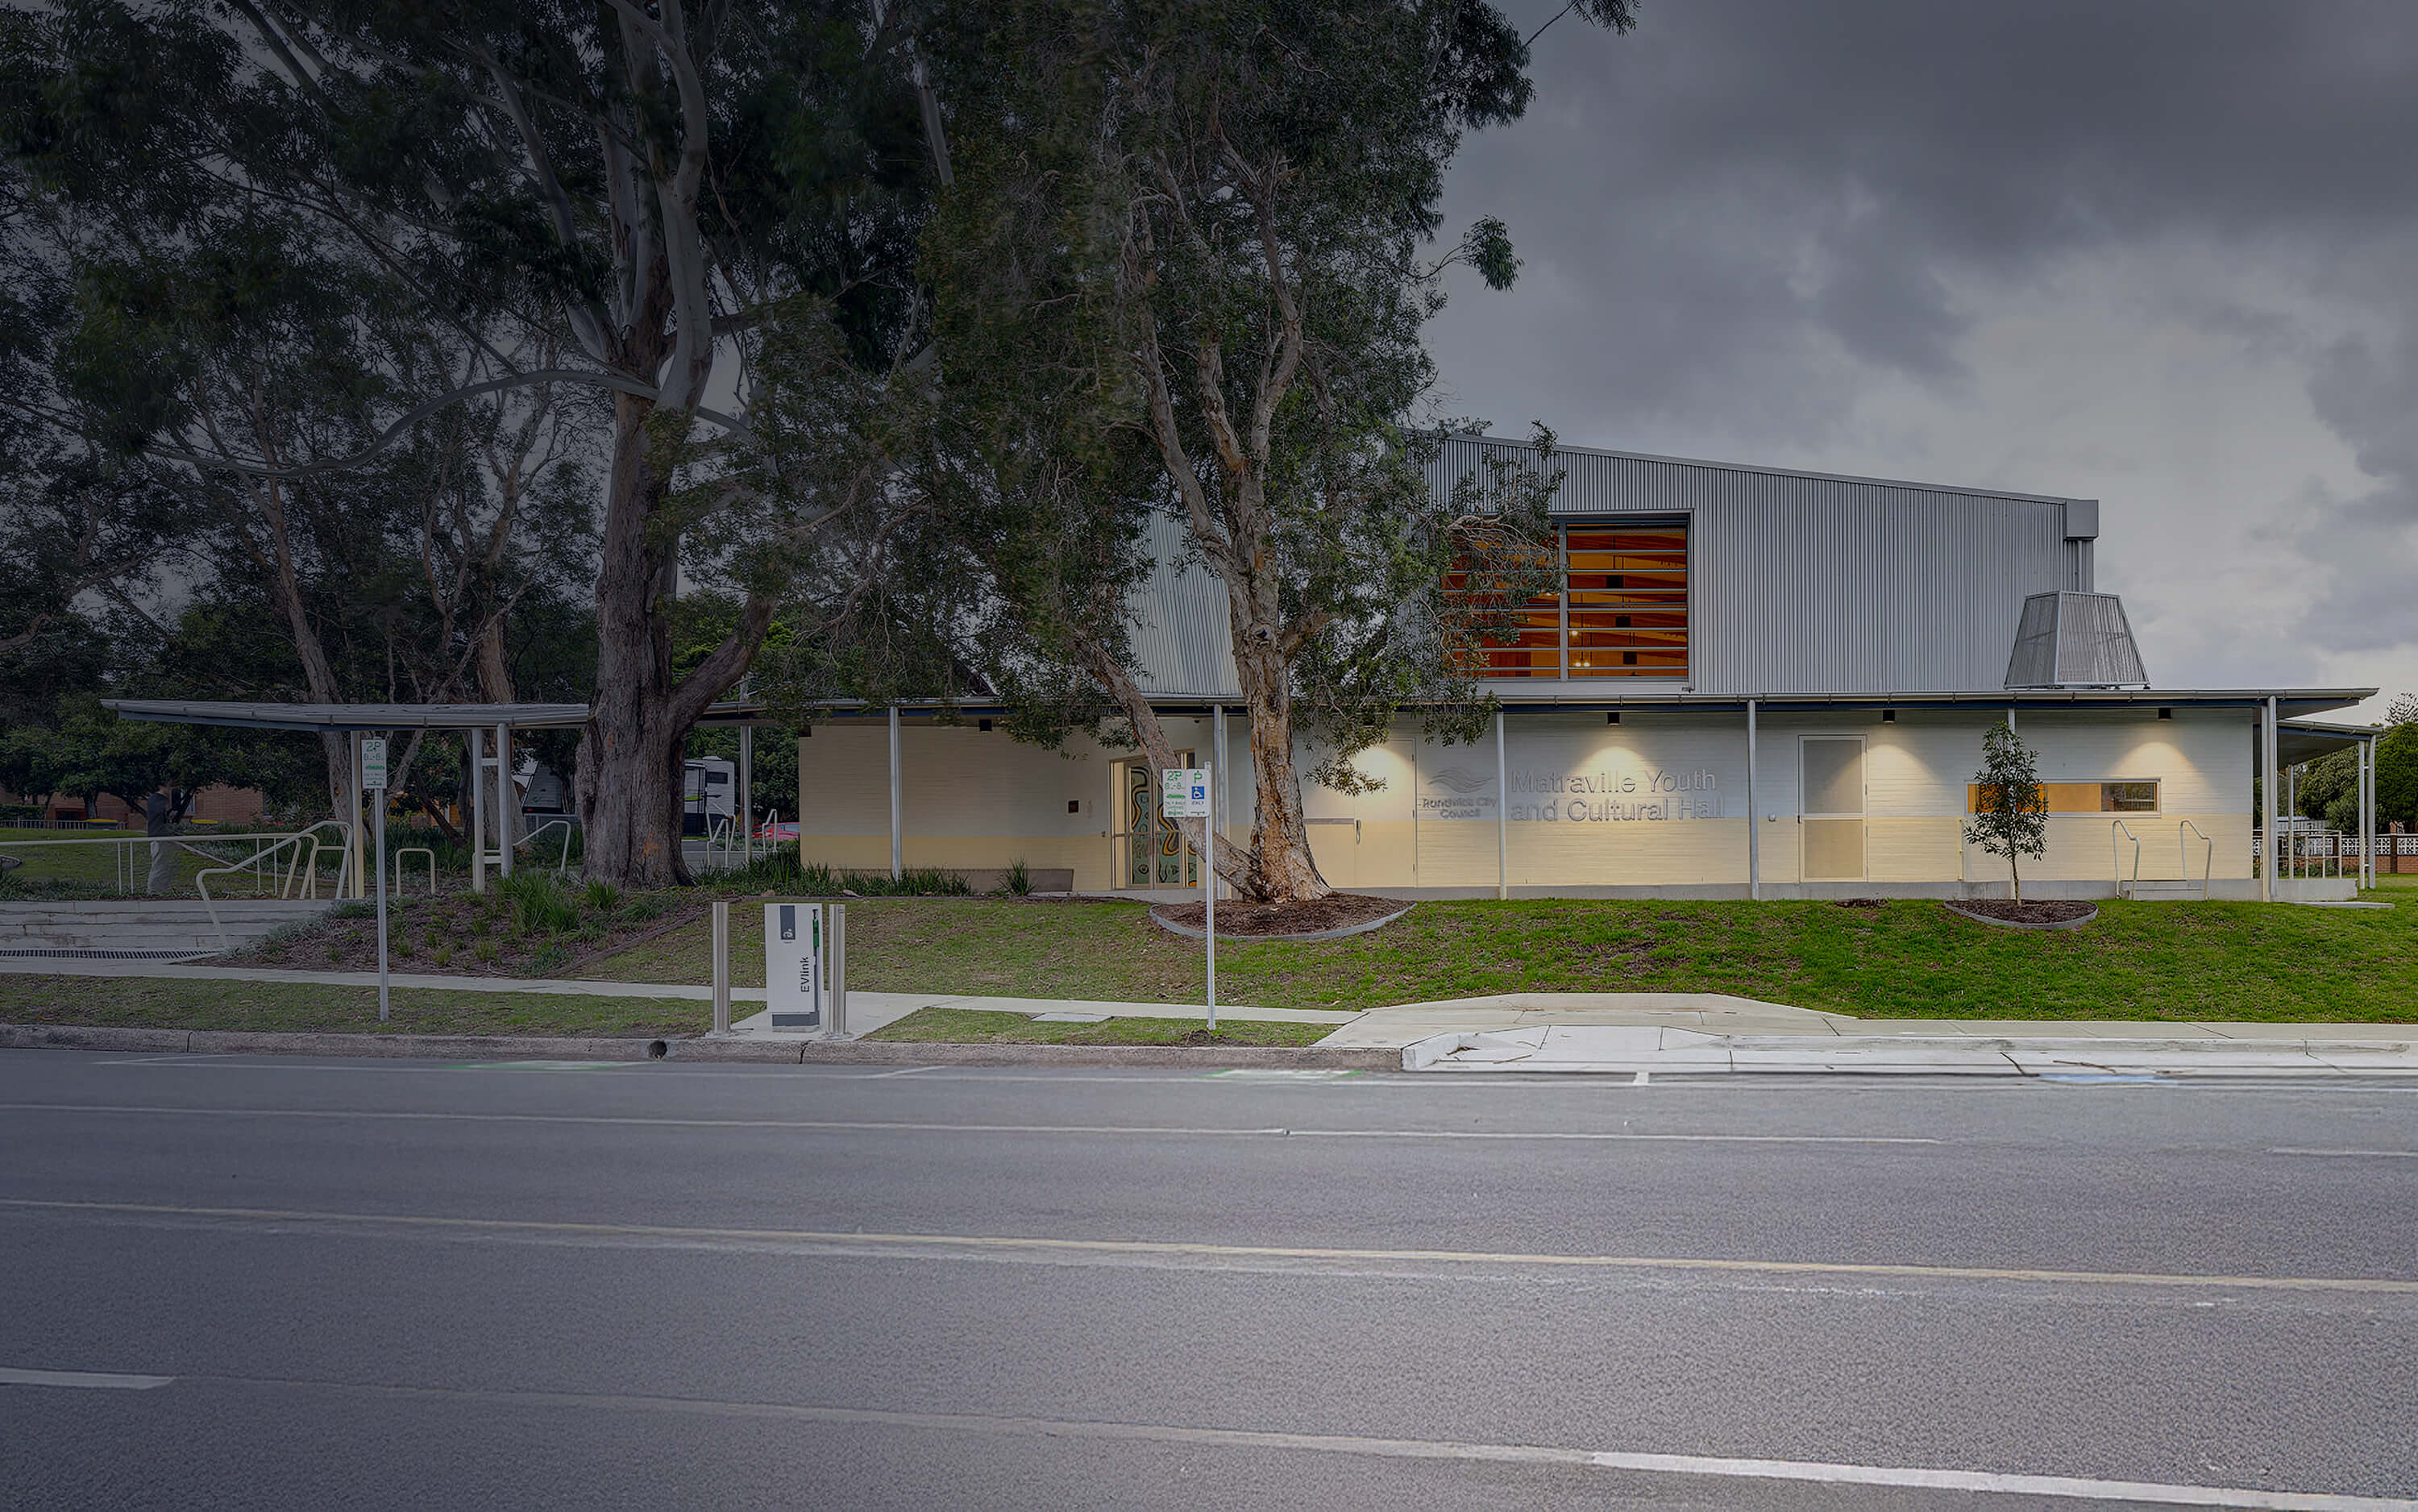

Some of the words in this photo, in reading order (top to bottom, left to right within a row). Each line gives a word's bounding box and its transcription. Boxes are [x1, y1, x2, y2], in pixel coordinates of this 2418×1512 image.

[1167, 771, 1182, 781] 2P
[1194, 773, 1203, 783] P
[1511, 769, 1636, 794] Matraville
[1645, 769, 1716, 793] Youth
[1510, 799, 1559, 821] and
[1567, 797, 1668, 822] Cultural
[1678, 795, 1725, 819] Hall
[800, 956, 810, 993] EVlink
